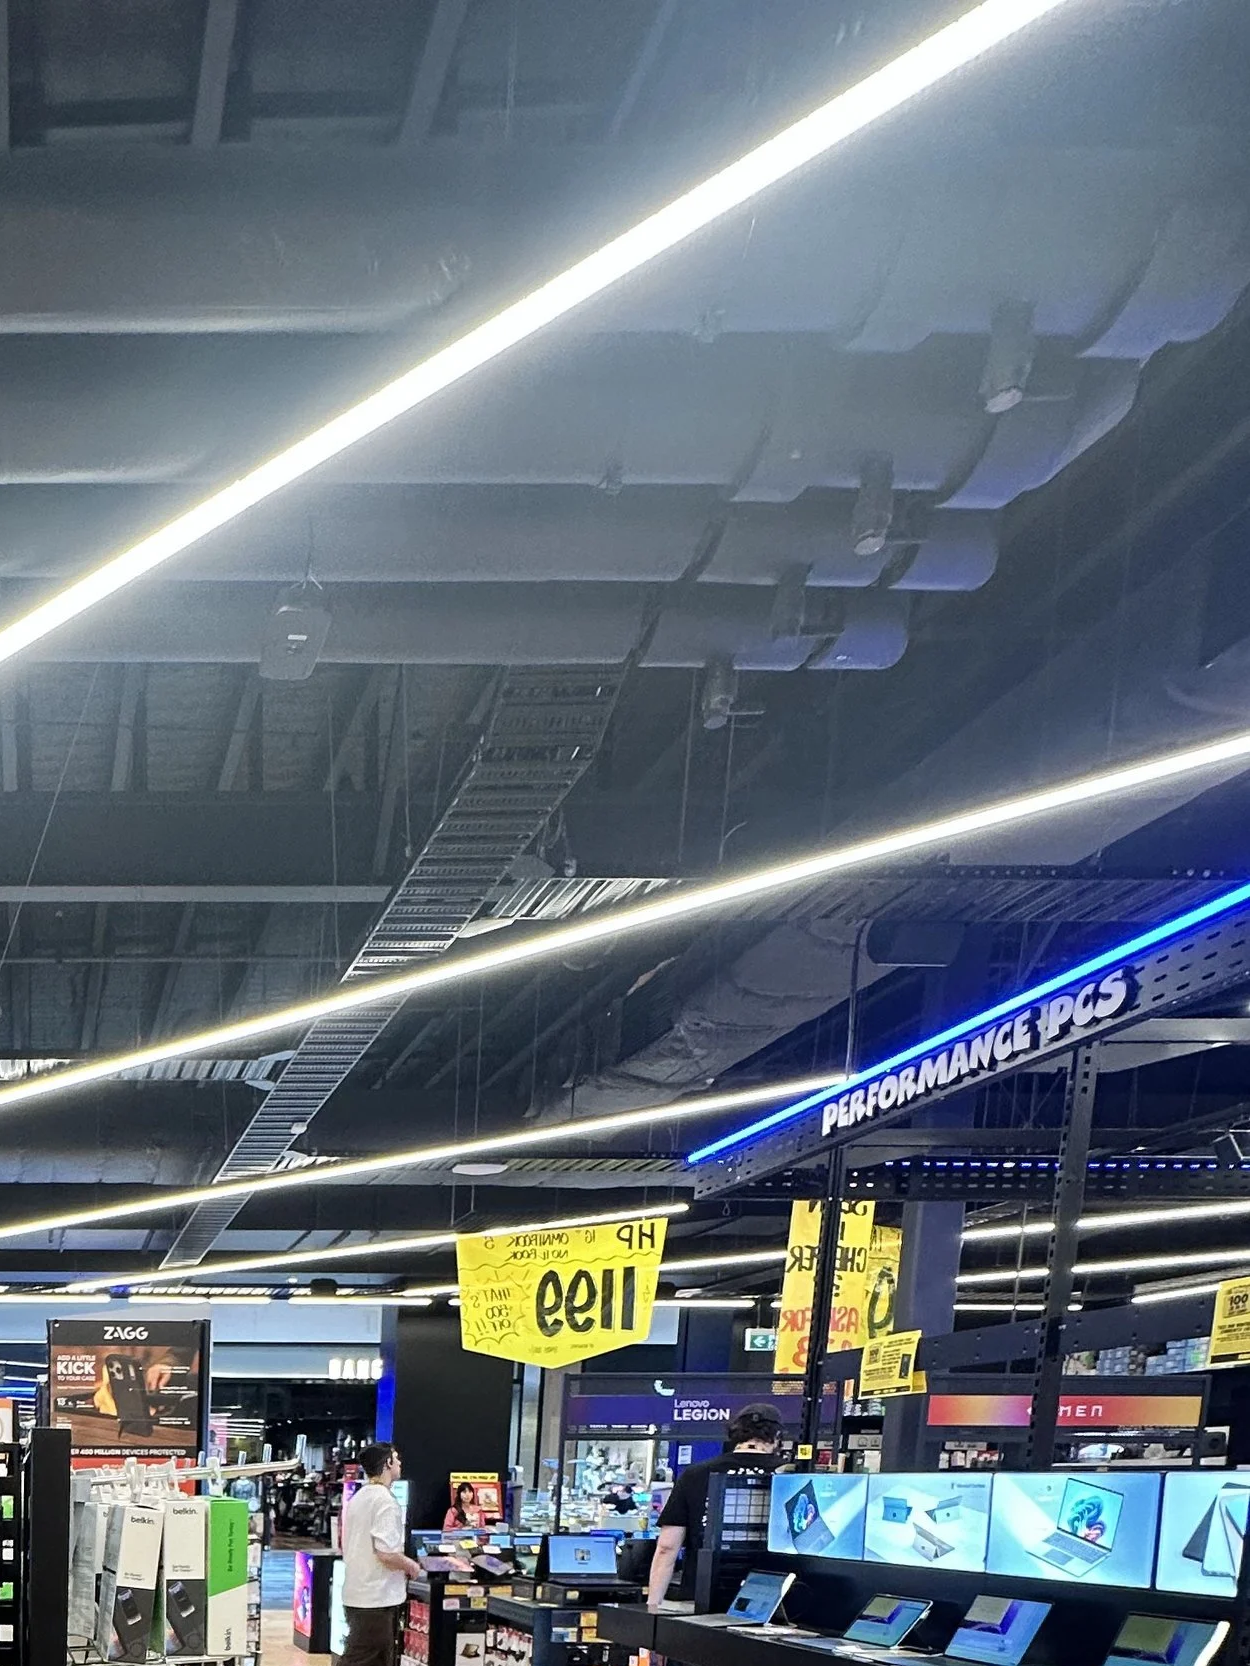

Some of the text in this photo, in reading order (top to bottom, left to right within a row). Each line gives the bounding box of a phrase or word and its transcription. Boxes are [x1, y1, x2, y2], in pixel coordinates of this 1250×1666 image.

[822, 1008, 1031, 1136] PERFORMANCE
[103, 1326, 149, 1340] ZAGG
[56, 1362, 96, 1375] KICK
[674, 1399, 710, 1408] Lenovo
[674, 1409, 731, 1421] LEGION
[1027, 1404, 1103, 1417] MEN
[131, 1516, 155, 1525] belkin
